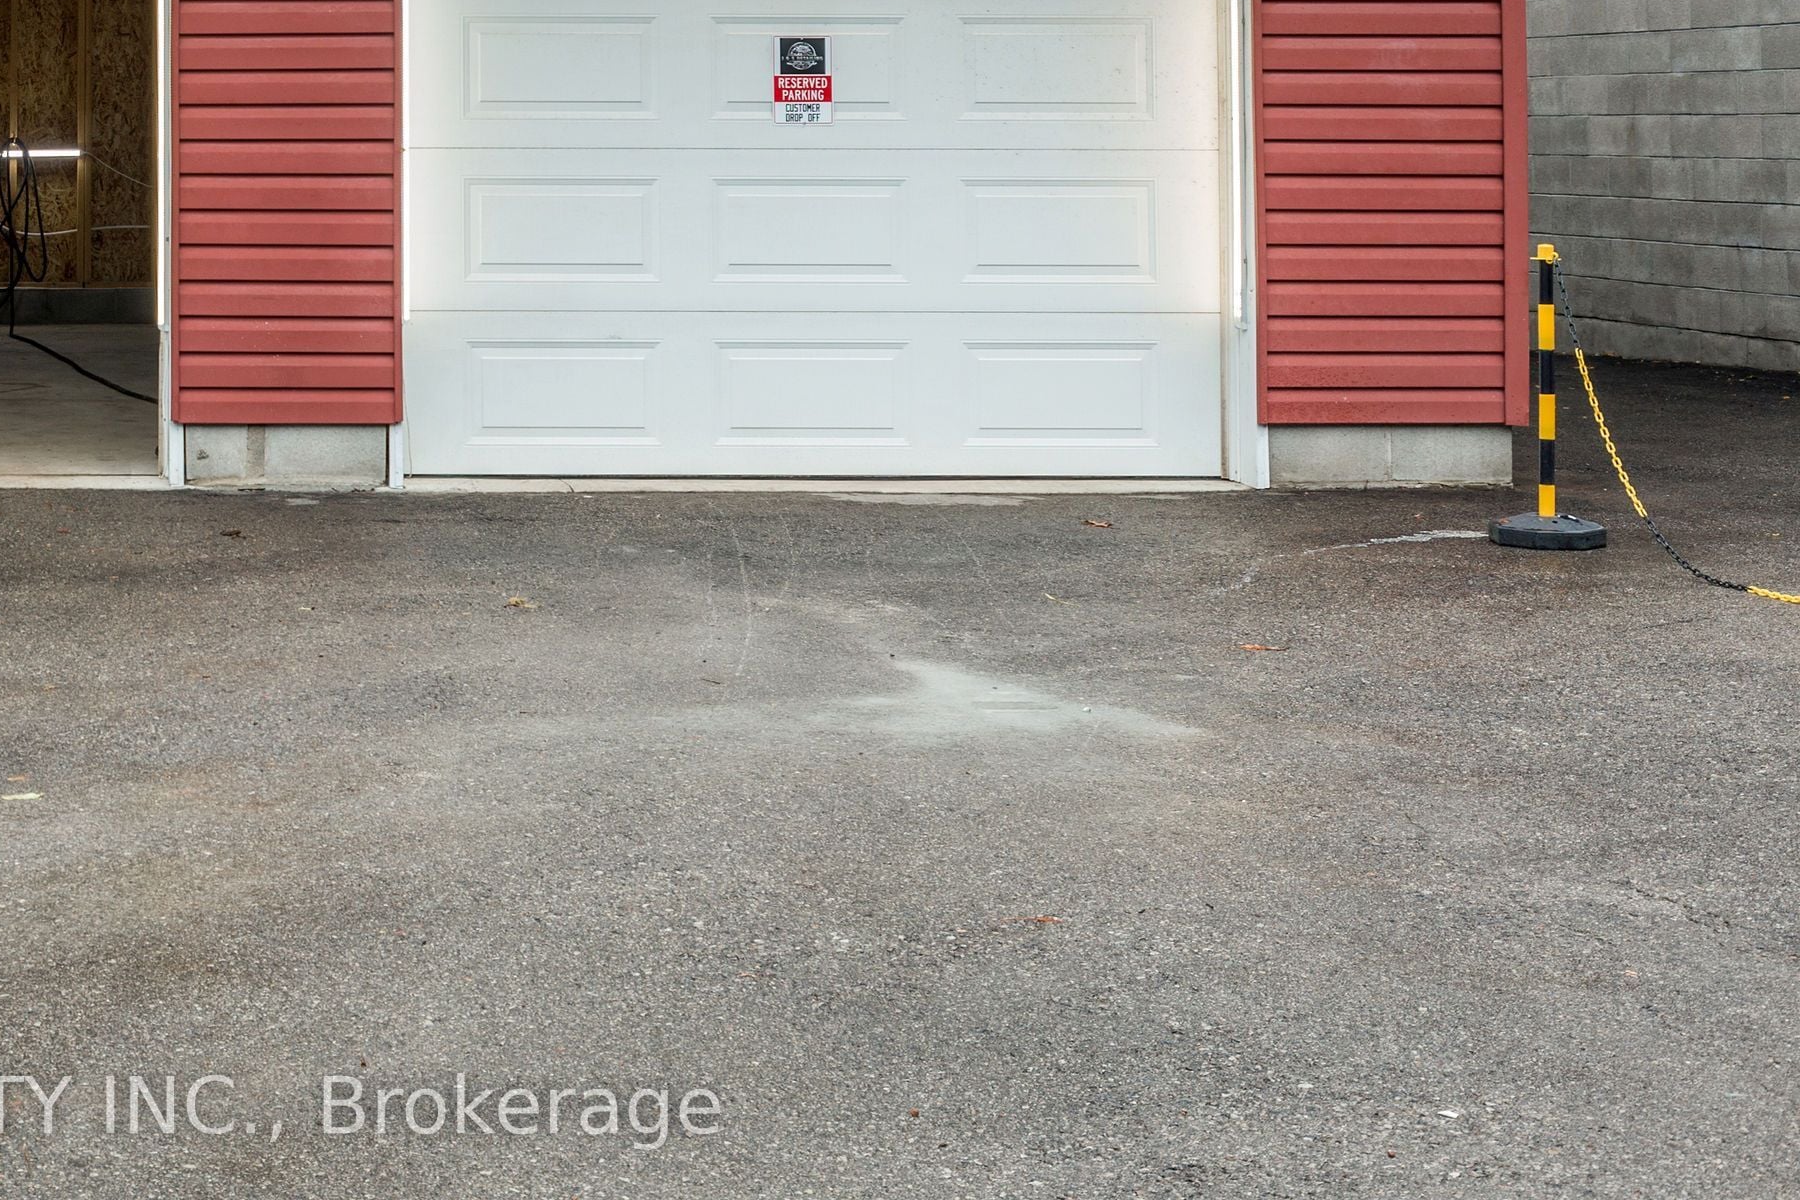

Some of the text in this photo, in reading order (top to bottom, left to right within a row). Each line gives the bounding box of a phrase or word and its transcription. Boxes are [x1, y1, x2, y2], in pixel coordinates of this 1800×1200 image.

[778, 77, 828, 89] RESERVED
[782, 90, 825, 101] PARKING
[785, 103, 821, 112] CUSTOMER
[785, 113, 821, 122] DROP OFF
